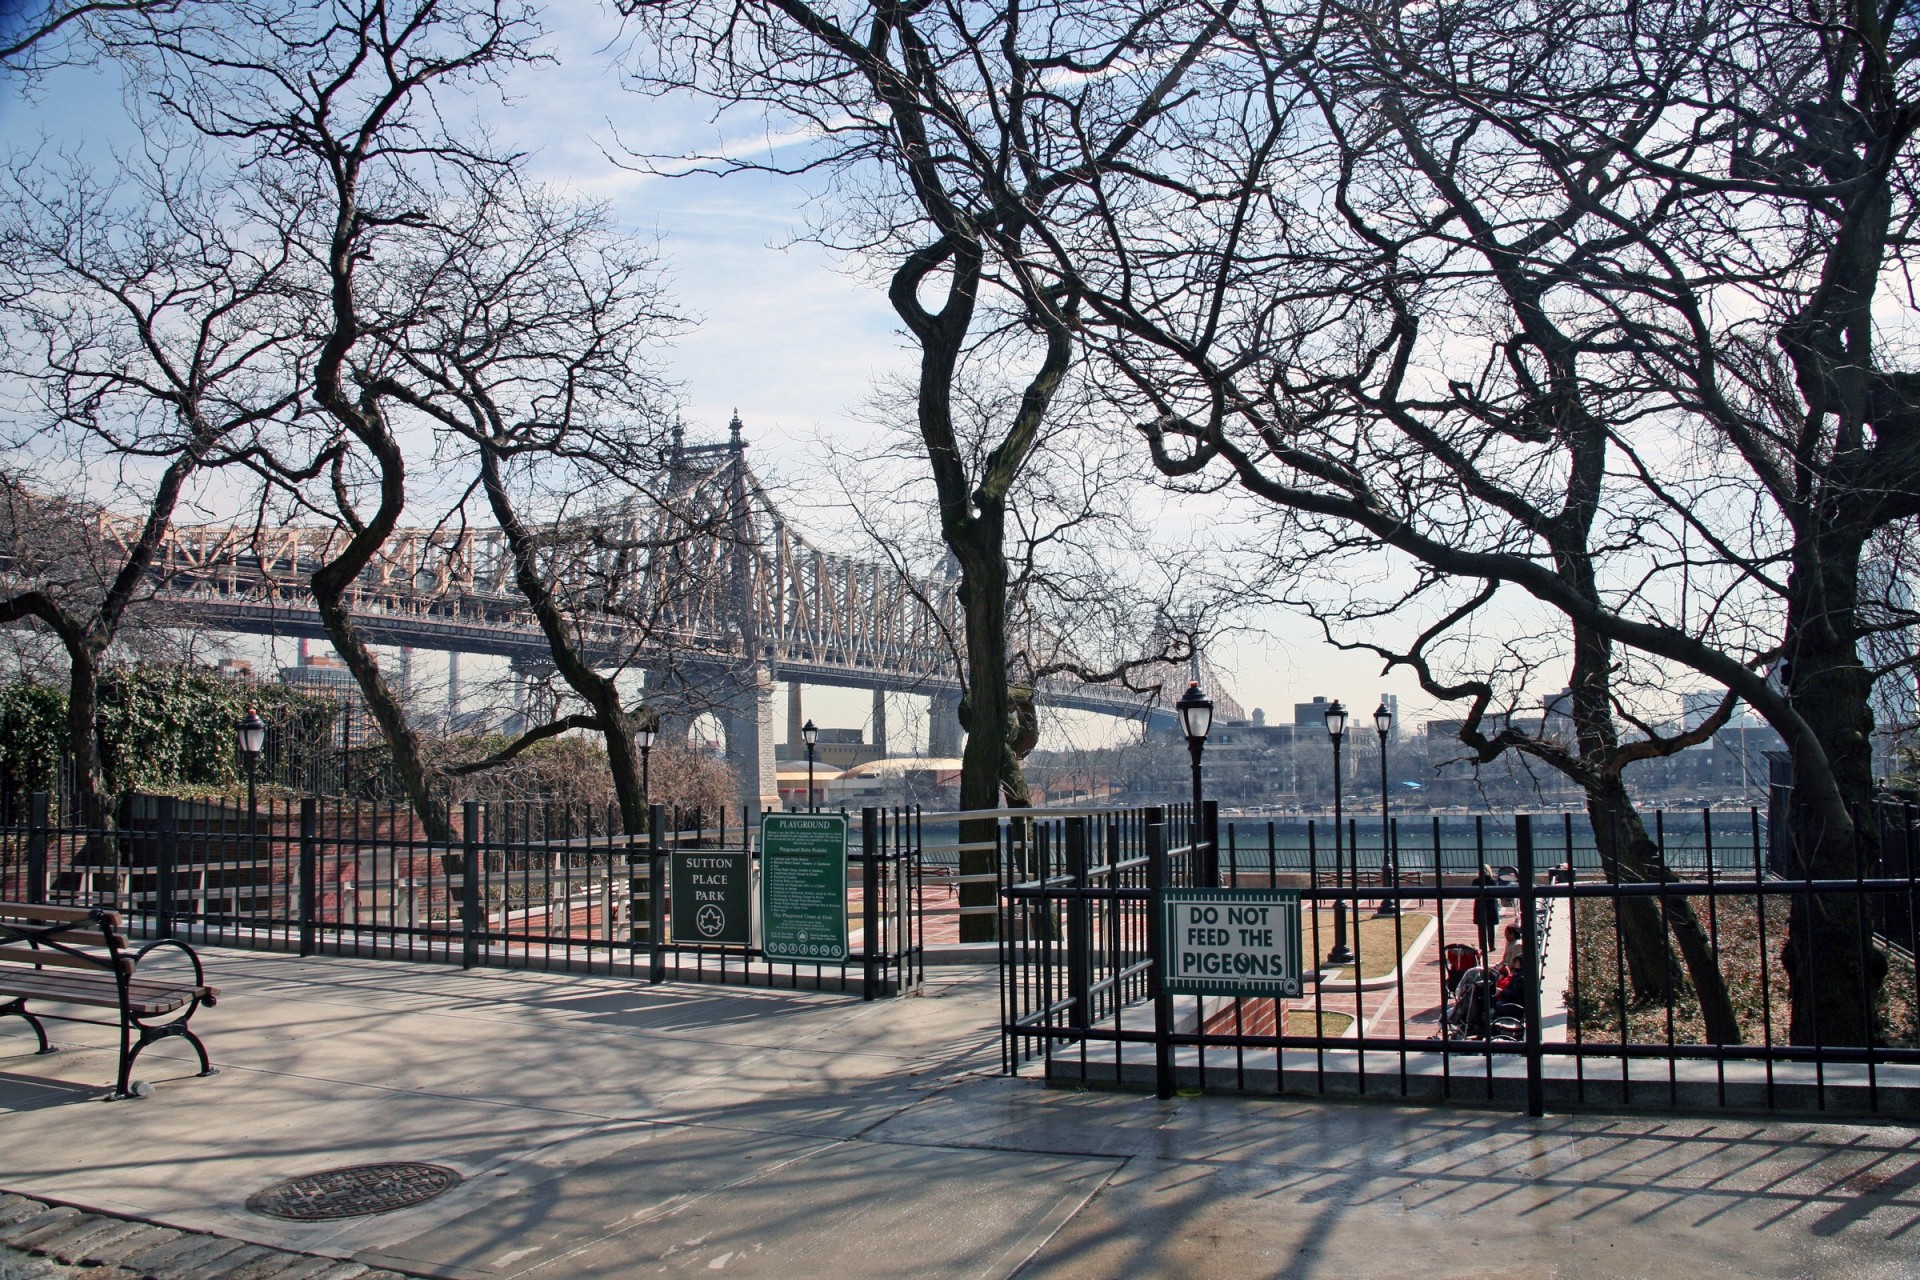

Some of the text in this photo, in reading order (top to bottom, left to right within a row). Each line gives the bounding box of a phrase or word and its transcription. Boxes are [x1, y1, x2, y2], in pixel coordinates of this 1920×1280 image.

[779, 820, 830, 829] PLAYGROUND
[686, 858, 733, 869] SUTTON
[692, 874, 728, 885] PLACE
[695, 890, 725, 901] PARK
[1190, 906, 1269, 926] DO NOT
[1187, 927, 1273, 947] FEED THE
[1182, 951, 1283, 976] PIGEONS
